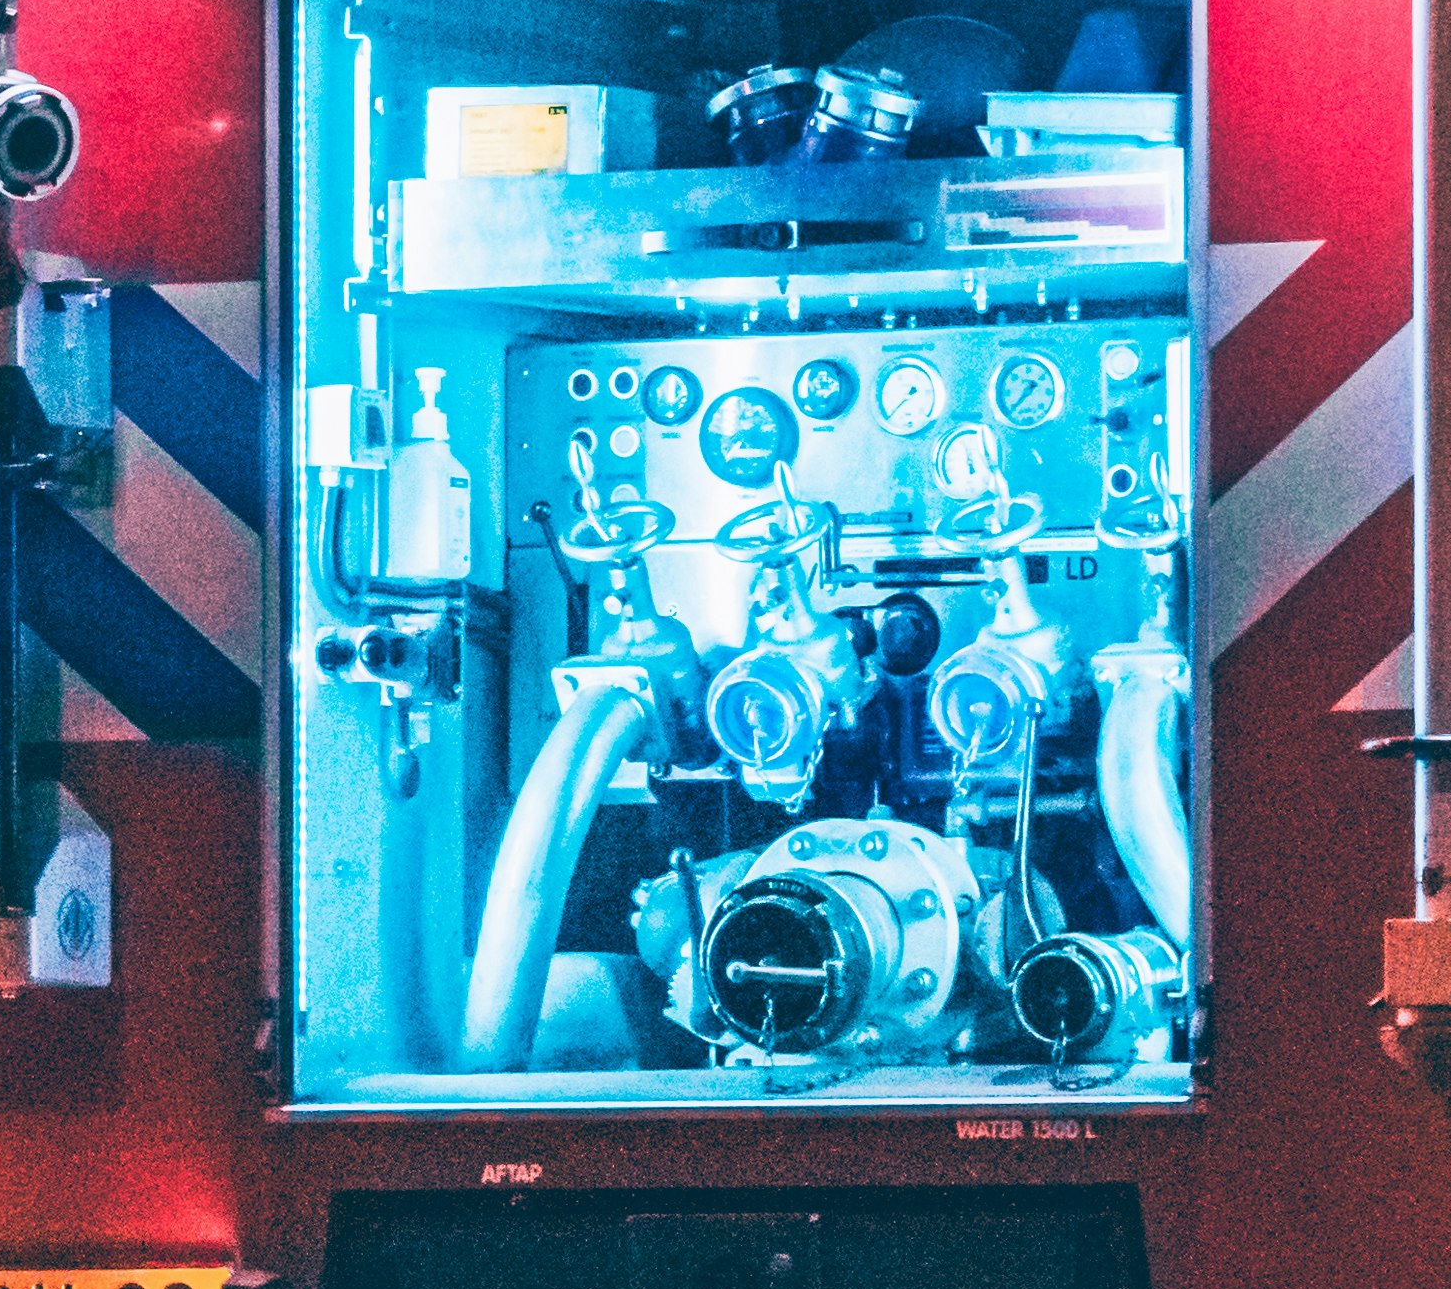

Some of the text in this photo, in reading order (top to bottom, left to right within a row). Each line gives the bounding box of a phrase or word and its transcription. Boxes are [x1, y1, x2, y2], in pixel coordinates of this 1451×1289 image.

[1065, 555, 1099, 581] LD
[956, 1119, 1024, 1140] WATER
[1084, 1119, 1098, 1139] L
[480, 1163, 543, 1184] AFTAP
